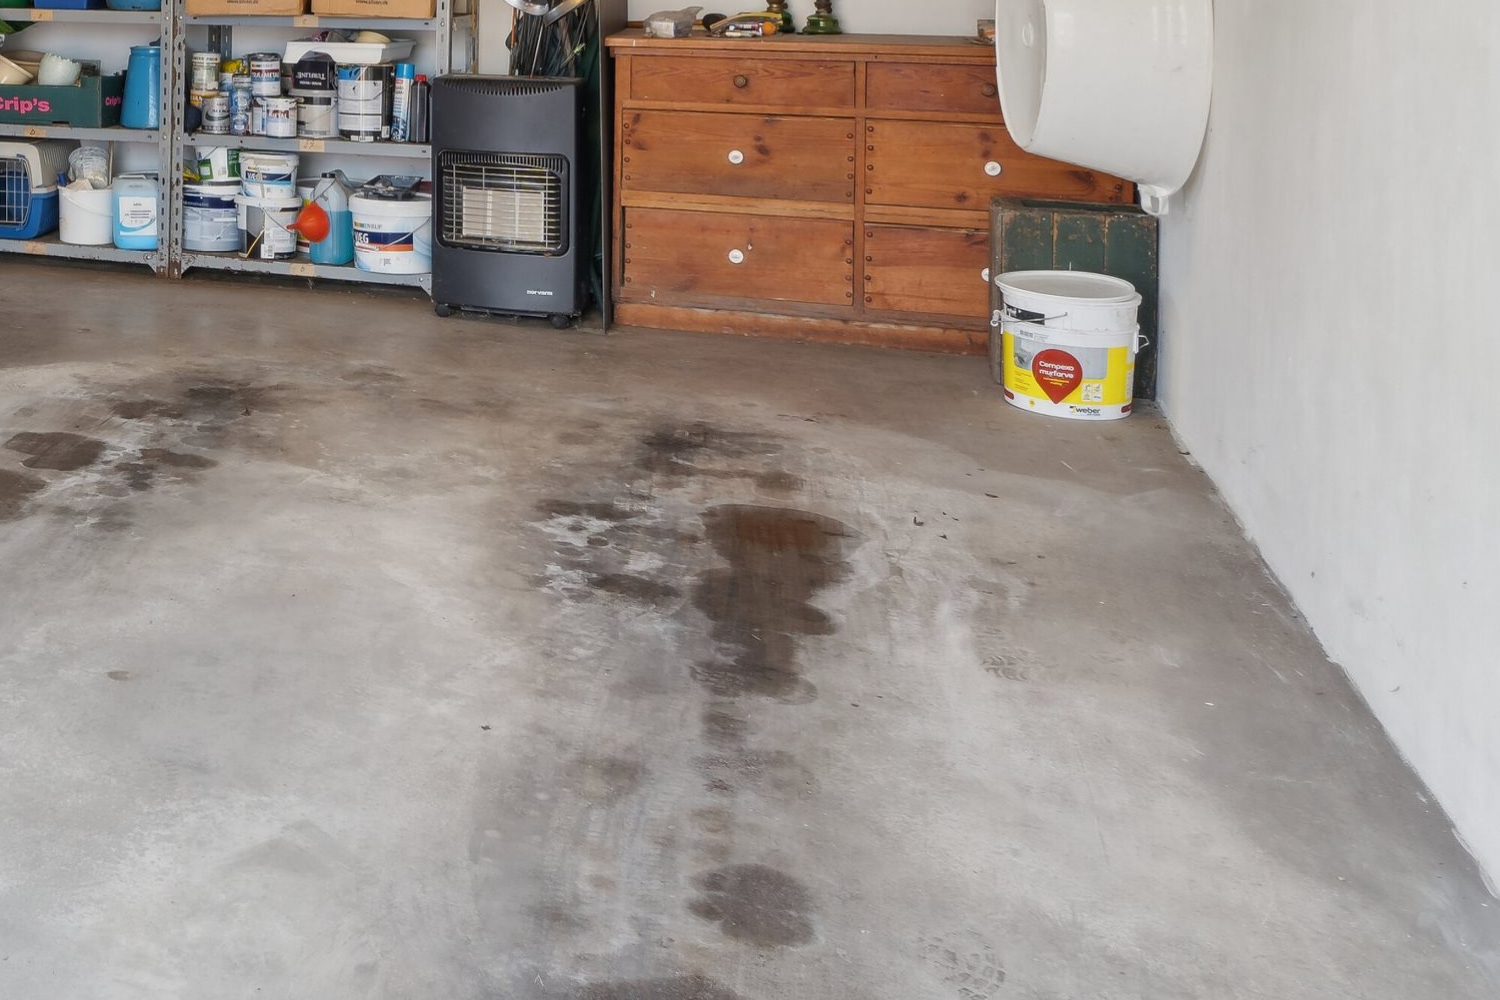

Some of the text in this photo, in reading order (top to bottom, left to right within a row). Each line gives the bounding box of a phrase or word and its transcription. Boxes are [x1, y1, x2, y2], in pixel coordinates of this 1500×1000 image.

[105, 96, 121, 107] Crip's
[1038, 360, 1074, 371] Cempexo
[1038, 369, 1074, 379] murfarve
